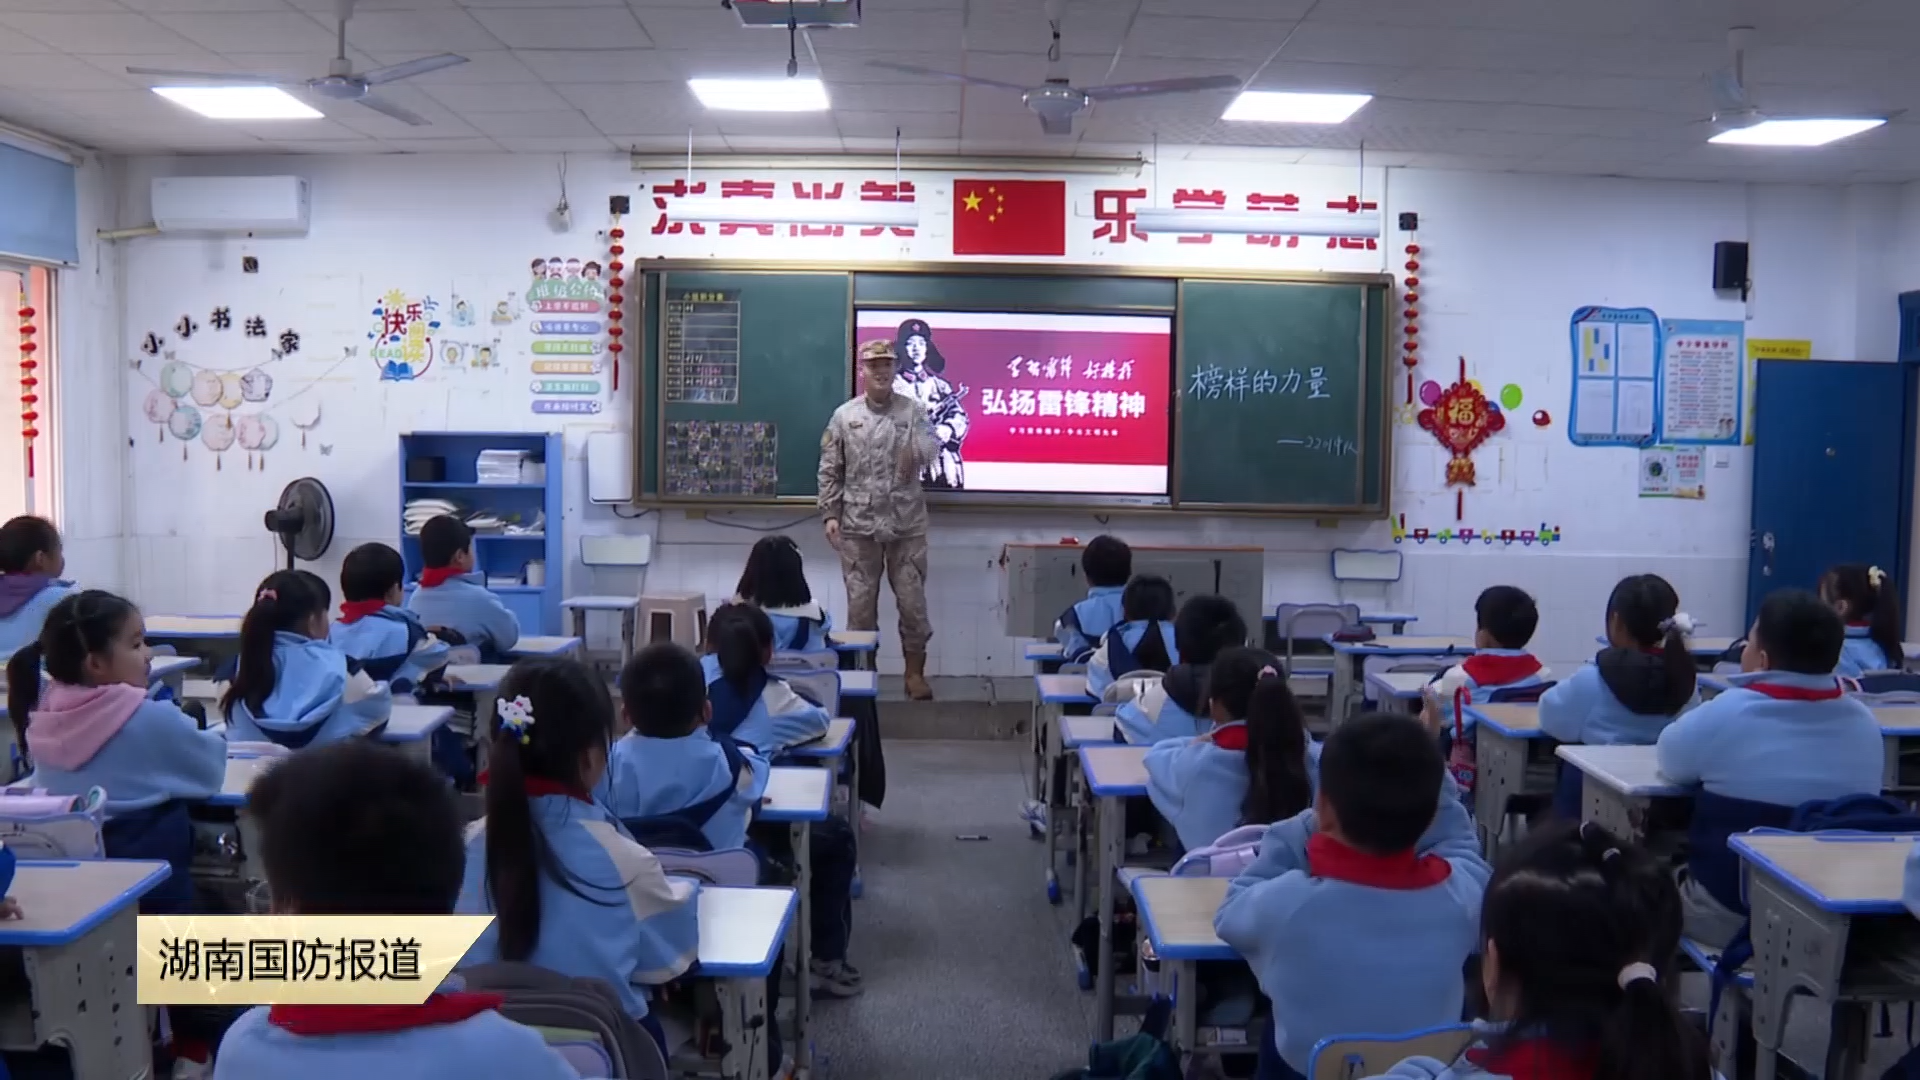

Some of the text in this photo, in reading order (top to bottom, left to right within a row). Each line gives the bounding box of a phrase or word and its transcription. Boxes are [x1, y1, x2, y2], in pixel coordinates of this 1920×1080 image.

[141, 305, 299, 354] 小小书法家
[383, 303, 423, 335] 快乐
[369, 347, 403, 358] READ
[1187, 363, 1331, 402] 榜样的力量
[981, 387, 1146, 419] 弘扬雷锋精神
[1448, 397, 1476, 426] 福
